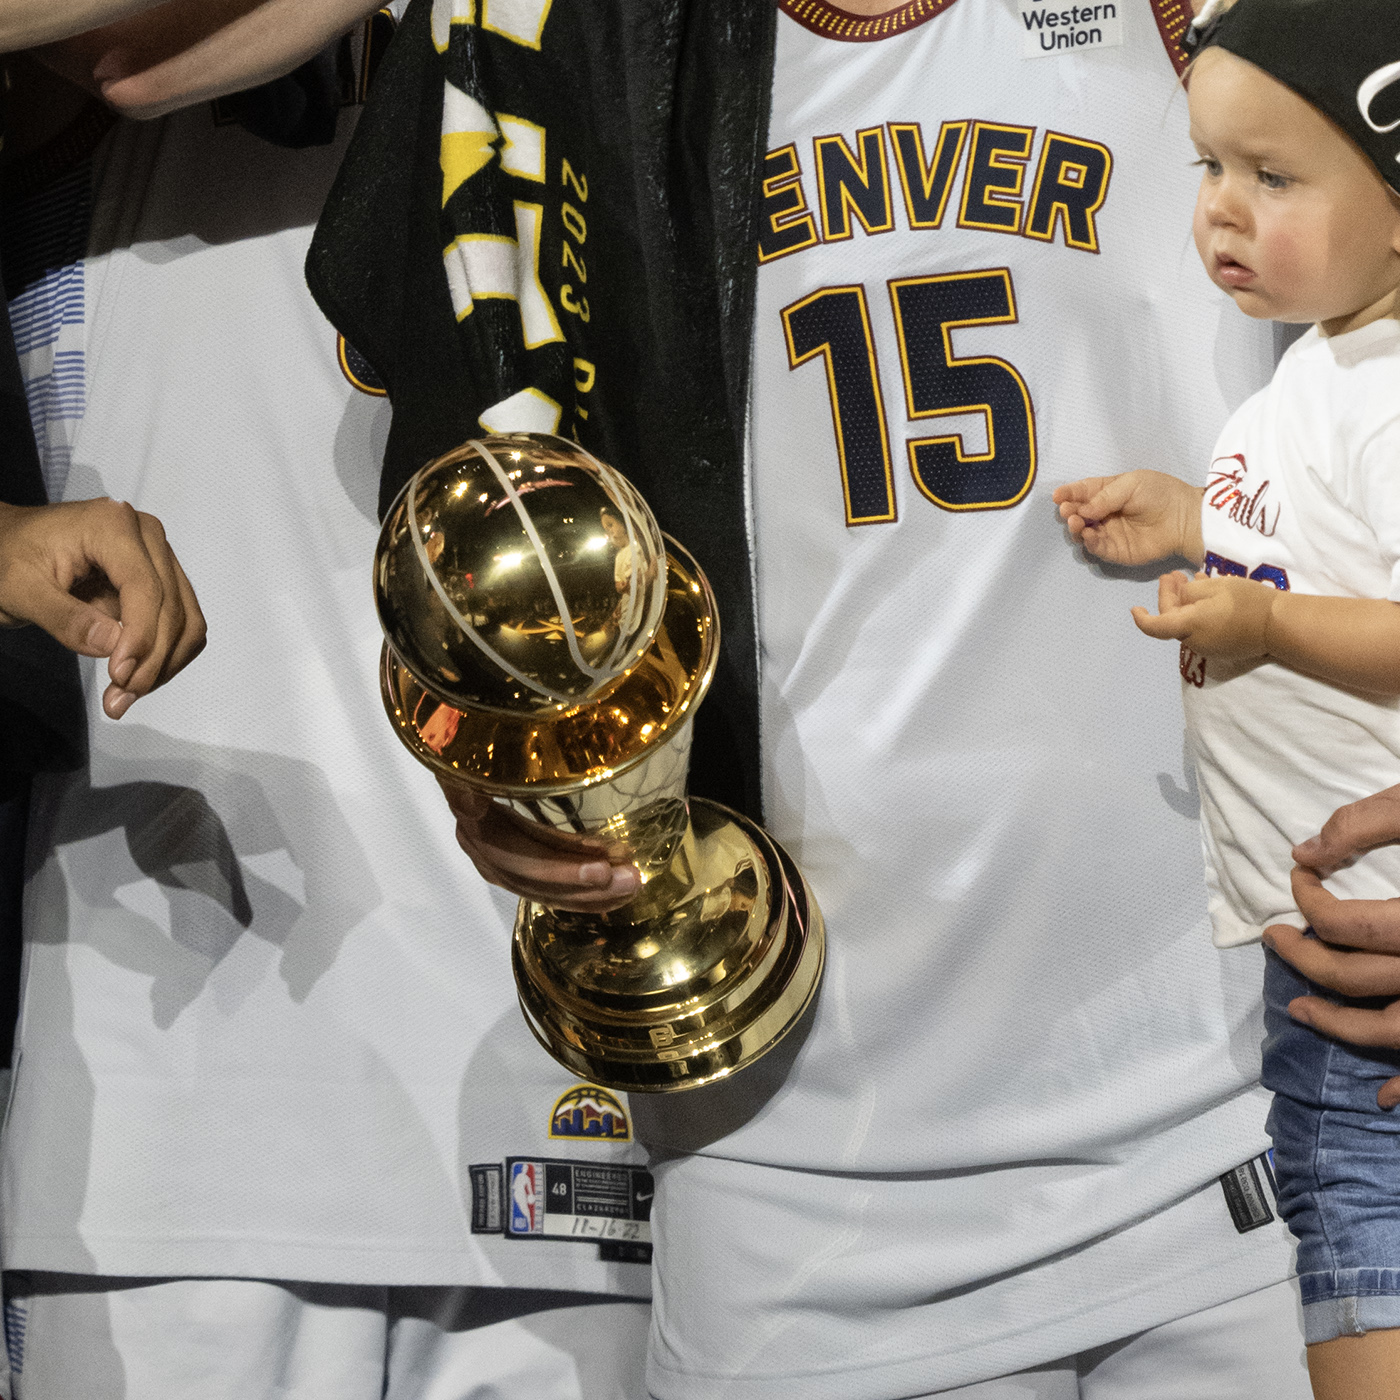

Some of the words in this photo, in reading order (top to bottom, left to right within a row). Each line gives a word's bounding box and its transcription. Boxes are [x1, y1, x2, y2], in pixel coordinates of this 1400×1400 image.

[1022, 3, 1116, 31] Western
[1040, 26, 1102, 51] Union
[757, 118, 1115, 267] ENVER
[560, 156, 591, 324] 2023
[780, 266, 1038, 528] 15
[551, 1182, 568, 1197] 48
